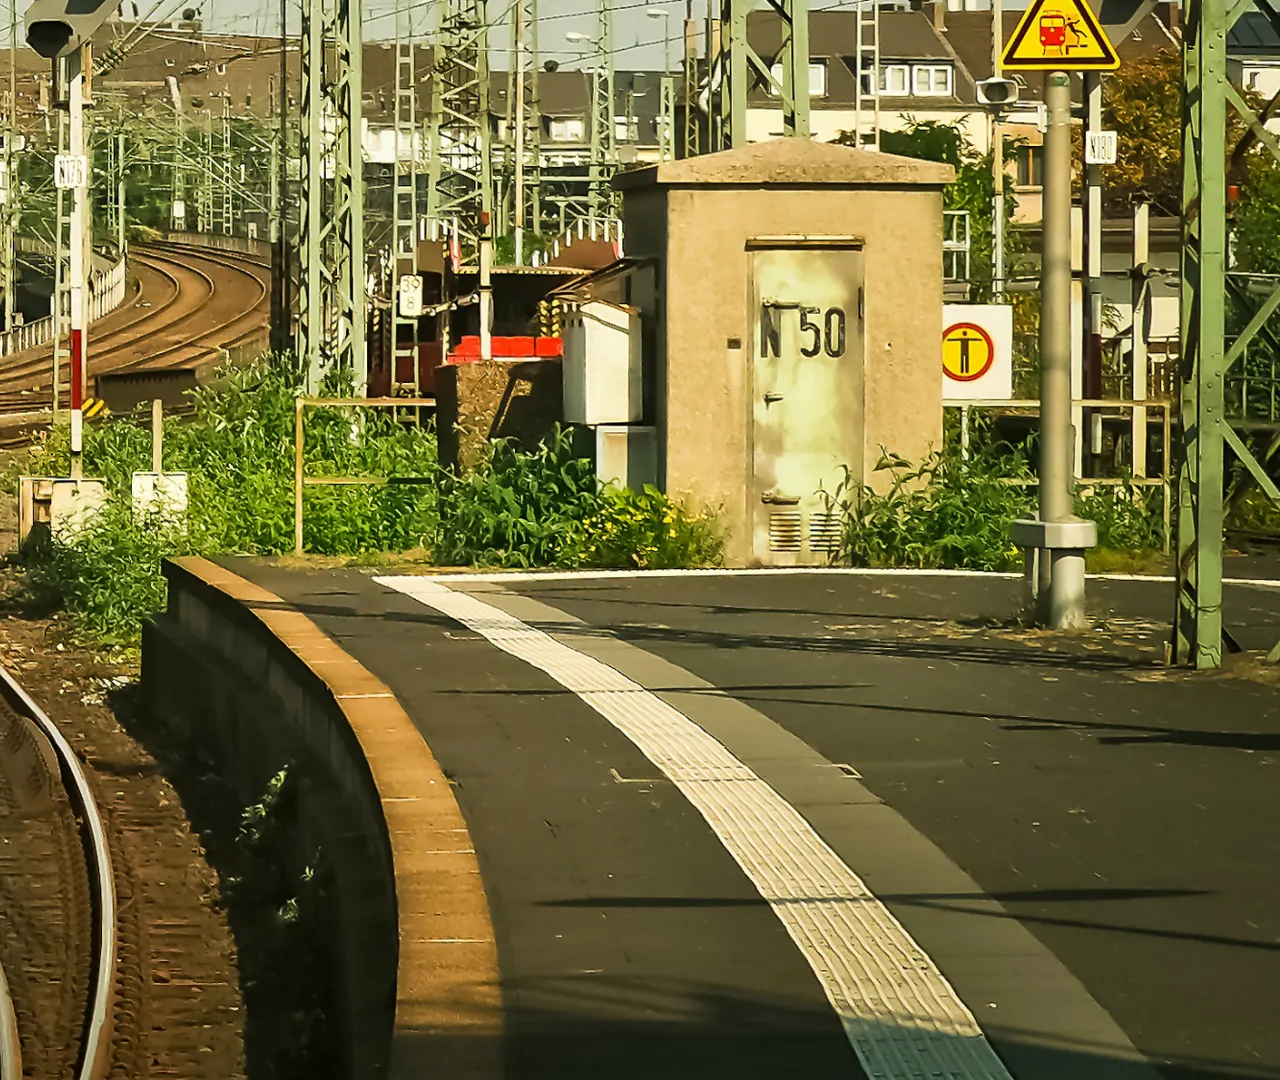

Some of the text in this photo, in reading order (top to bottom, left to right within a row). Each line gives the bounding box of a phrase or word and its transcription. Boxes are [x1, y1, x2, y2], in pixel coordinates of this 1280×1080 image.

[407, 295, 415, 309] 8
[760, 305, 846, 358] N 50
